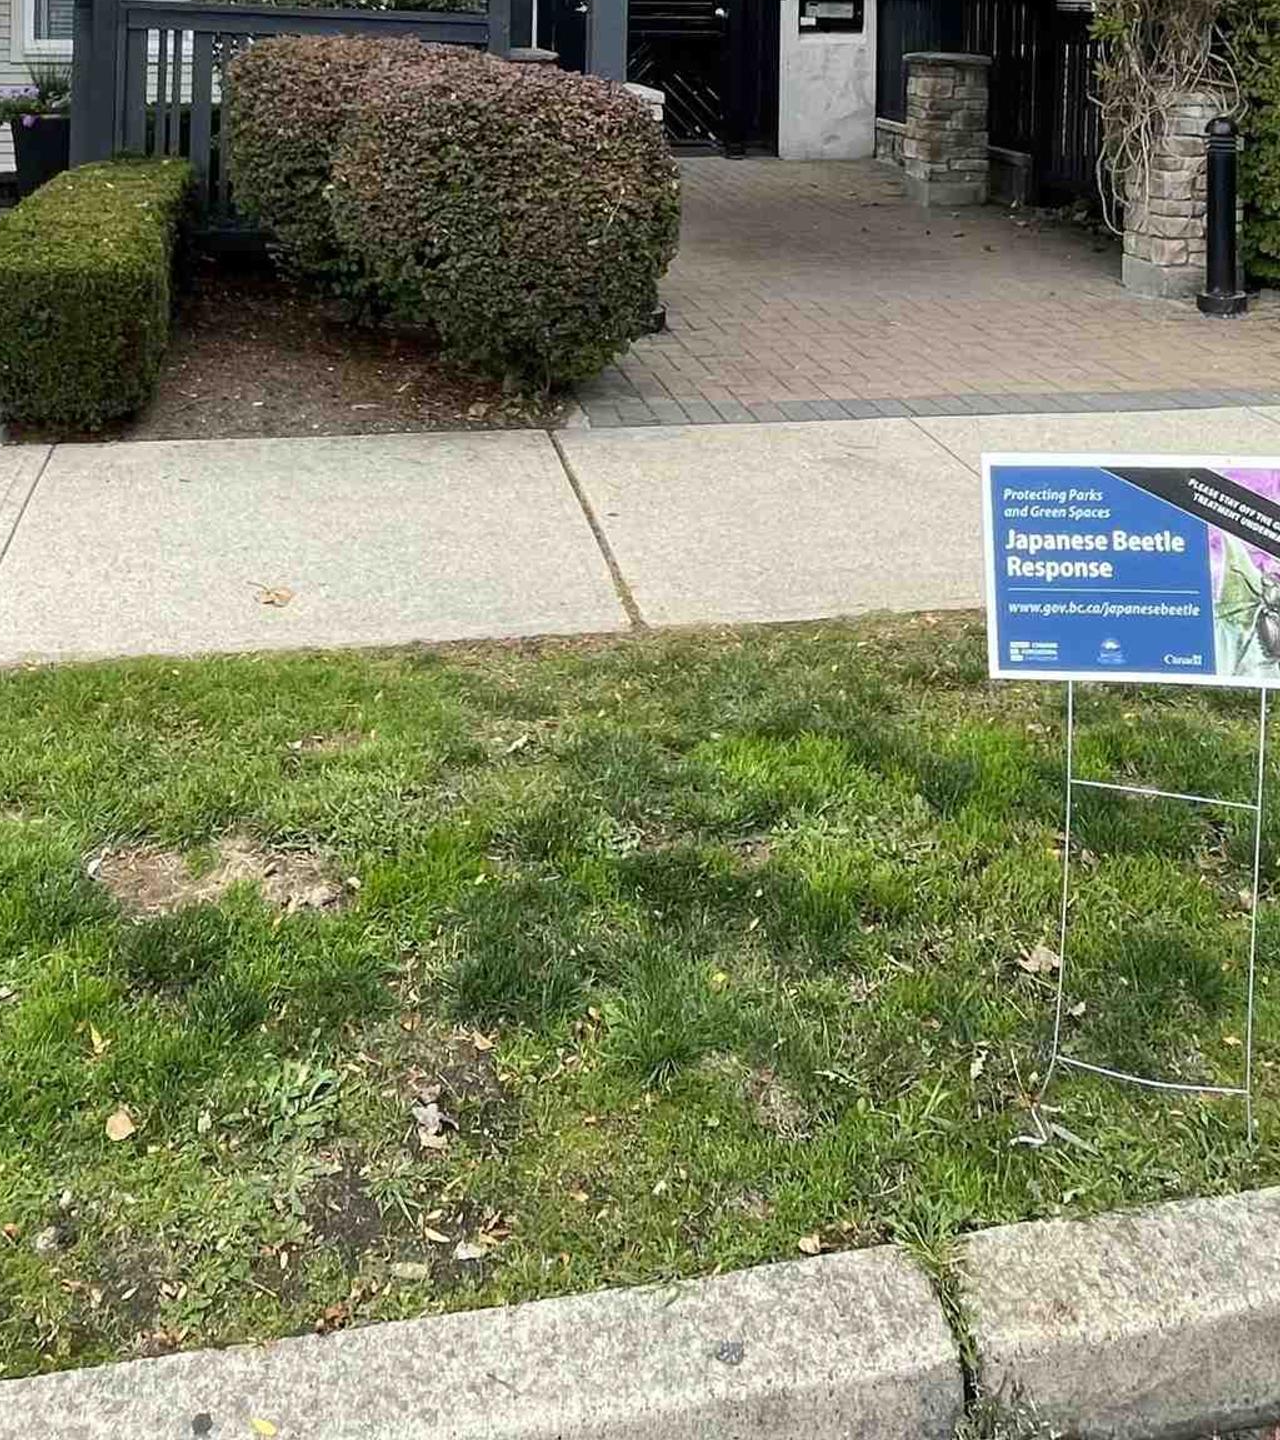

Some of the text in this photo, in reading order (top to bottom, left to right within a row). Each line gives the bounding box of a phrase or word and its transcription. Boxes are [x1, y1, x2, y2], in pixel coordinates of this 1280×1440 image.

[1003, 488, 1104, 504] Protecting Parks
[1188, 478, 1220, 499] PLEASE
[1219, 493, 1241, 508] STAY
[1239, 504, 1257, 517] OFF
[1256, 512, 1273, 527] THE
[1192, 492, 1241, 521] TREATMENT
[1004, 505, 1112, 520] and Green Spaces
[1005, 528, 1186, 555] Japanese Beetle
[1006, 555, 1114, 582] Response
[1008, 601, 1202, 617] www.gov.bc.ca/japanesebeetle
